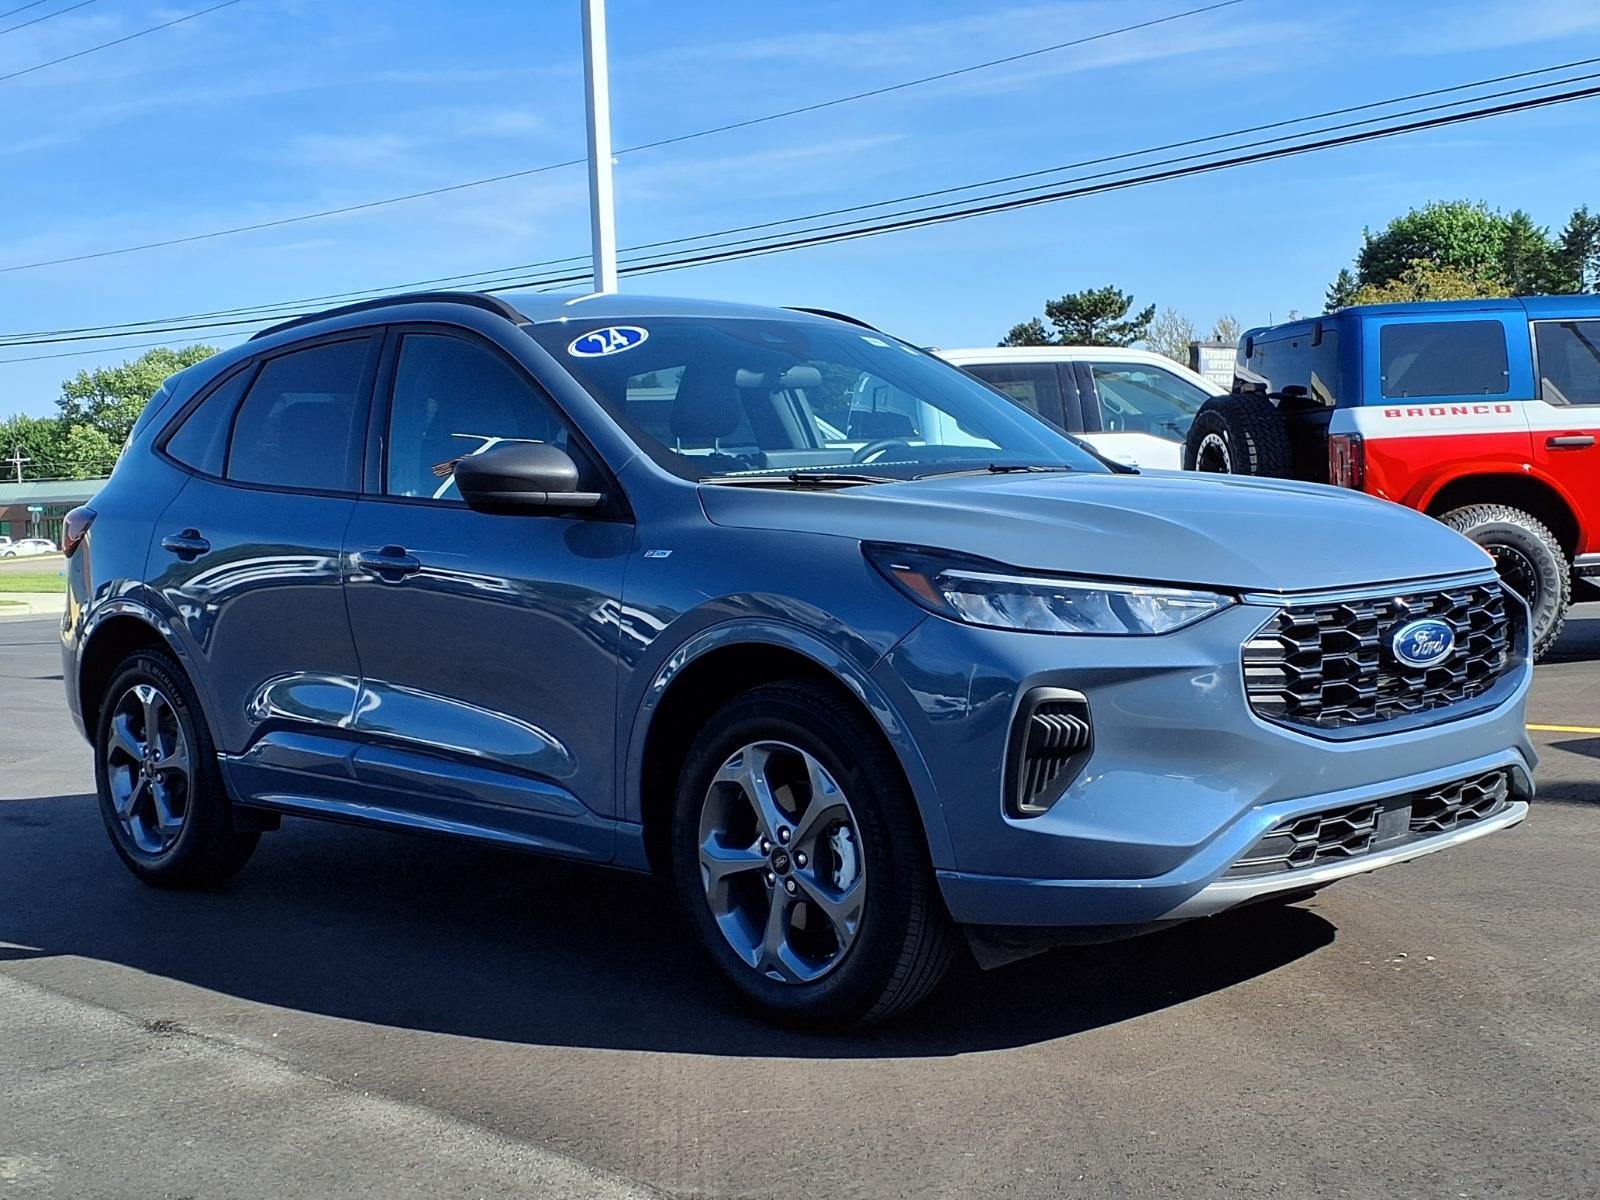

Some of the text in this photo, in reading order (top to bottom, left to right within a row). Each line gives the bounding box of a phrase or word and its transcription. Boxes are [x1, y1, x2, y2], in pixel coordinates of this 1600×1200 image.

[588, 327, 629, 353] 24
[1383, 404, 1512, 418] BRONCO
[1411, 628, 1445, 657] Ford
